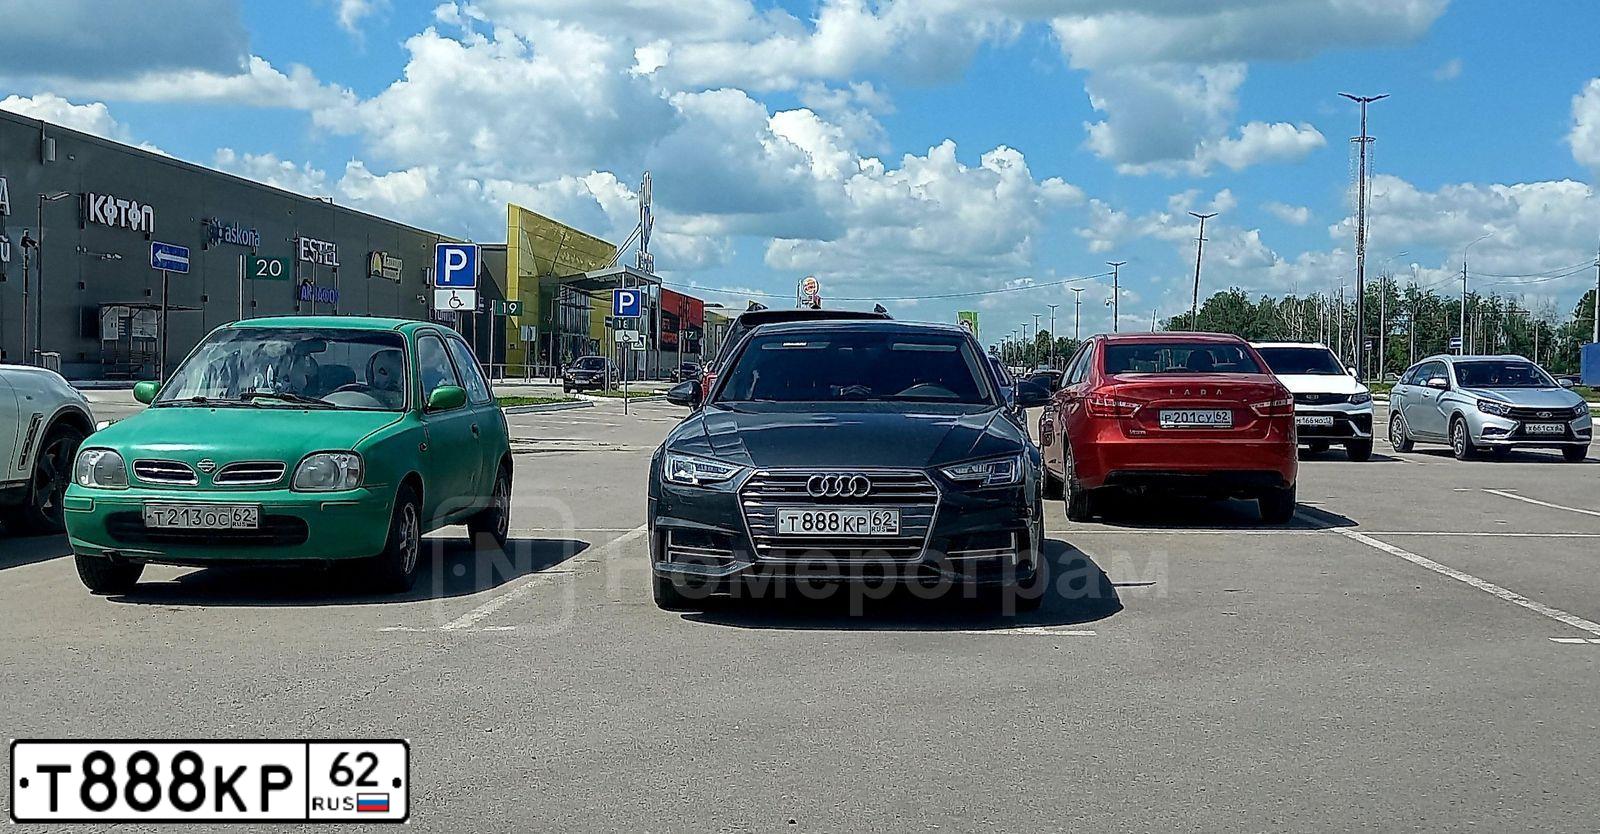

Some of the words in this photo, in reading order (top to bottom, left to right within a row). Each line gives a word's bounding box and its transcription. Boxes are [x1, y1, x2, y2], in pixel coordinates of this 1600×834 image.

[225, 221, 260, 247] askona
[300, 237, 340, 267] ESTEL
[256, 260, 282, 277] 20
[445, 249, 467, 282] P
[502, 302, 517, 314] 19
[619, 292, 635, 314] P
[685, 331, 694, 339] 17
[1216, 412, 1228, 420] 62
[233, 508, 251, 522] 62
[872, 511, 892, 526] 62
